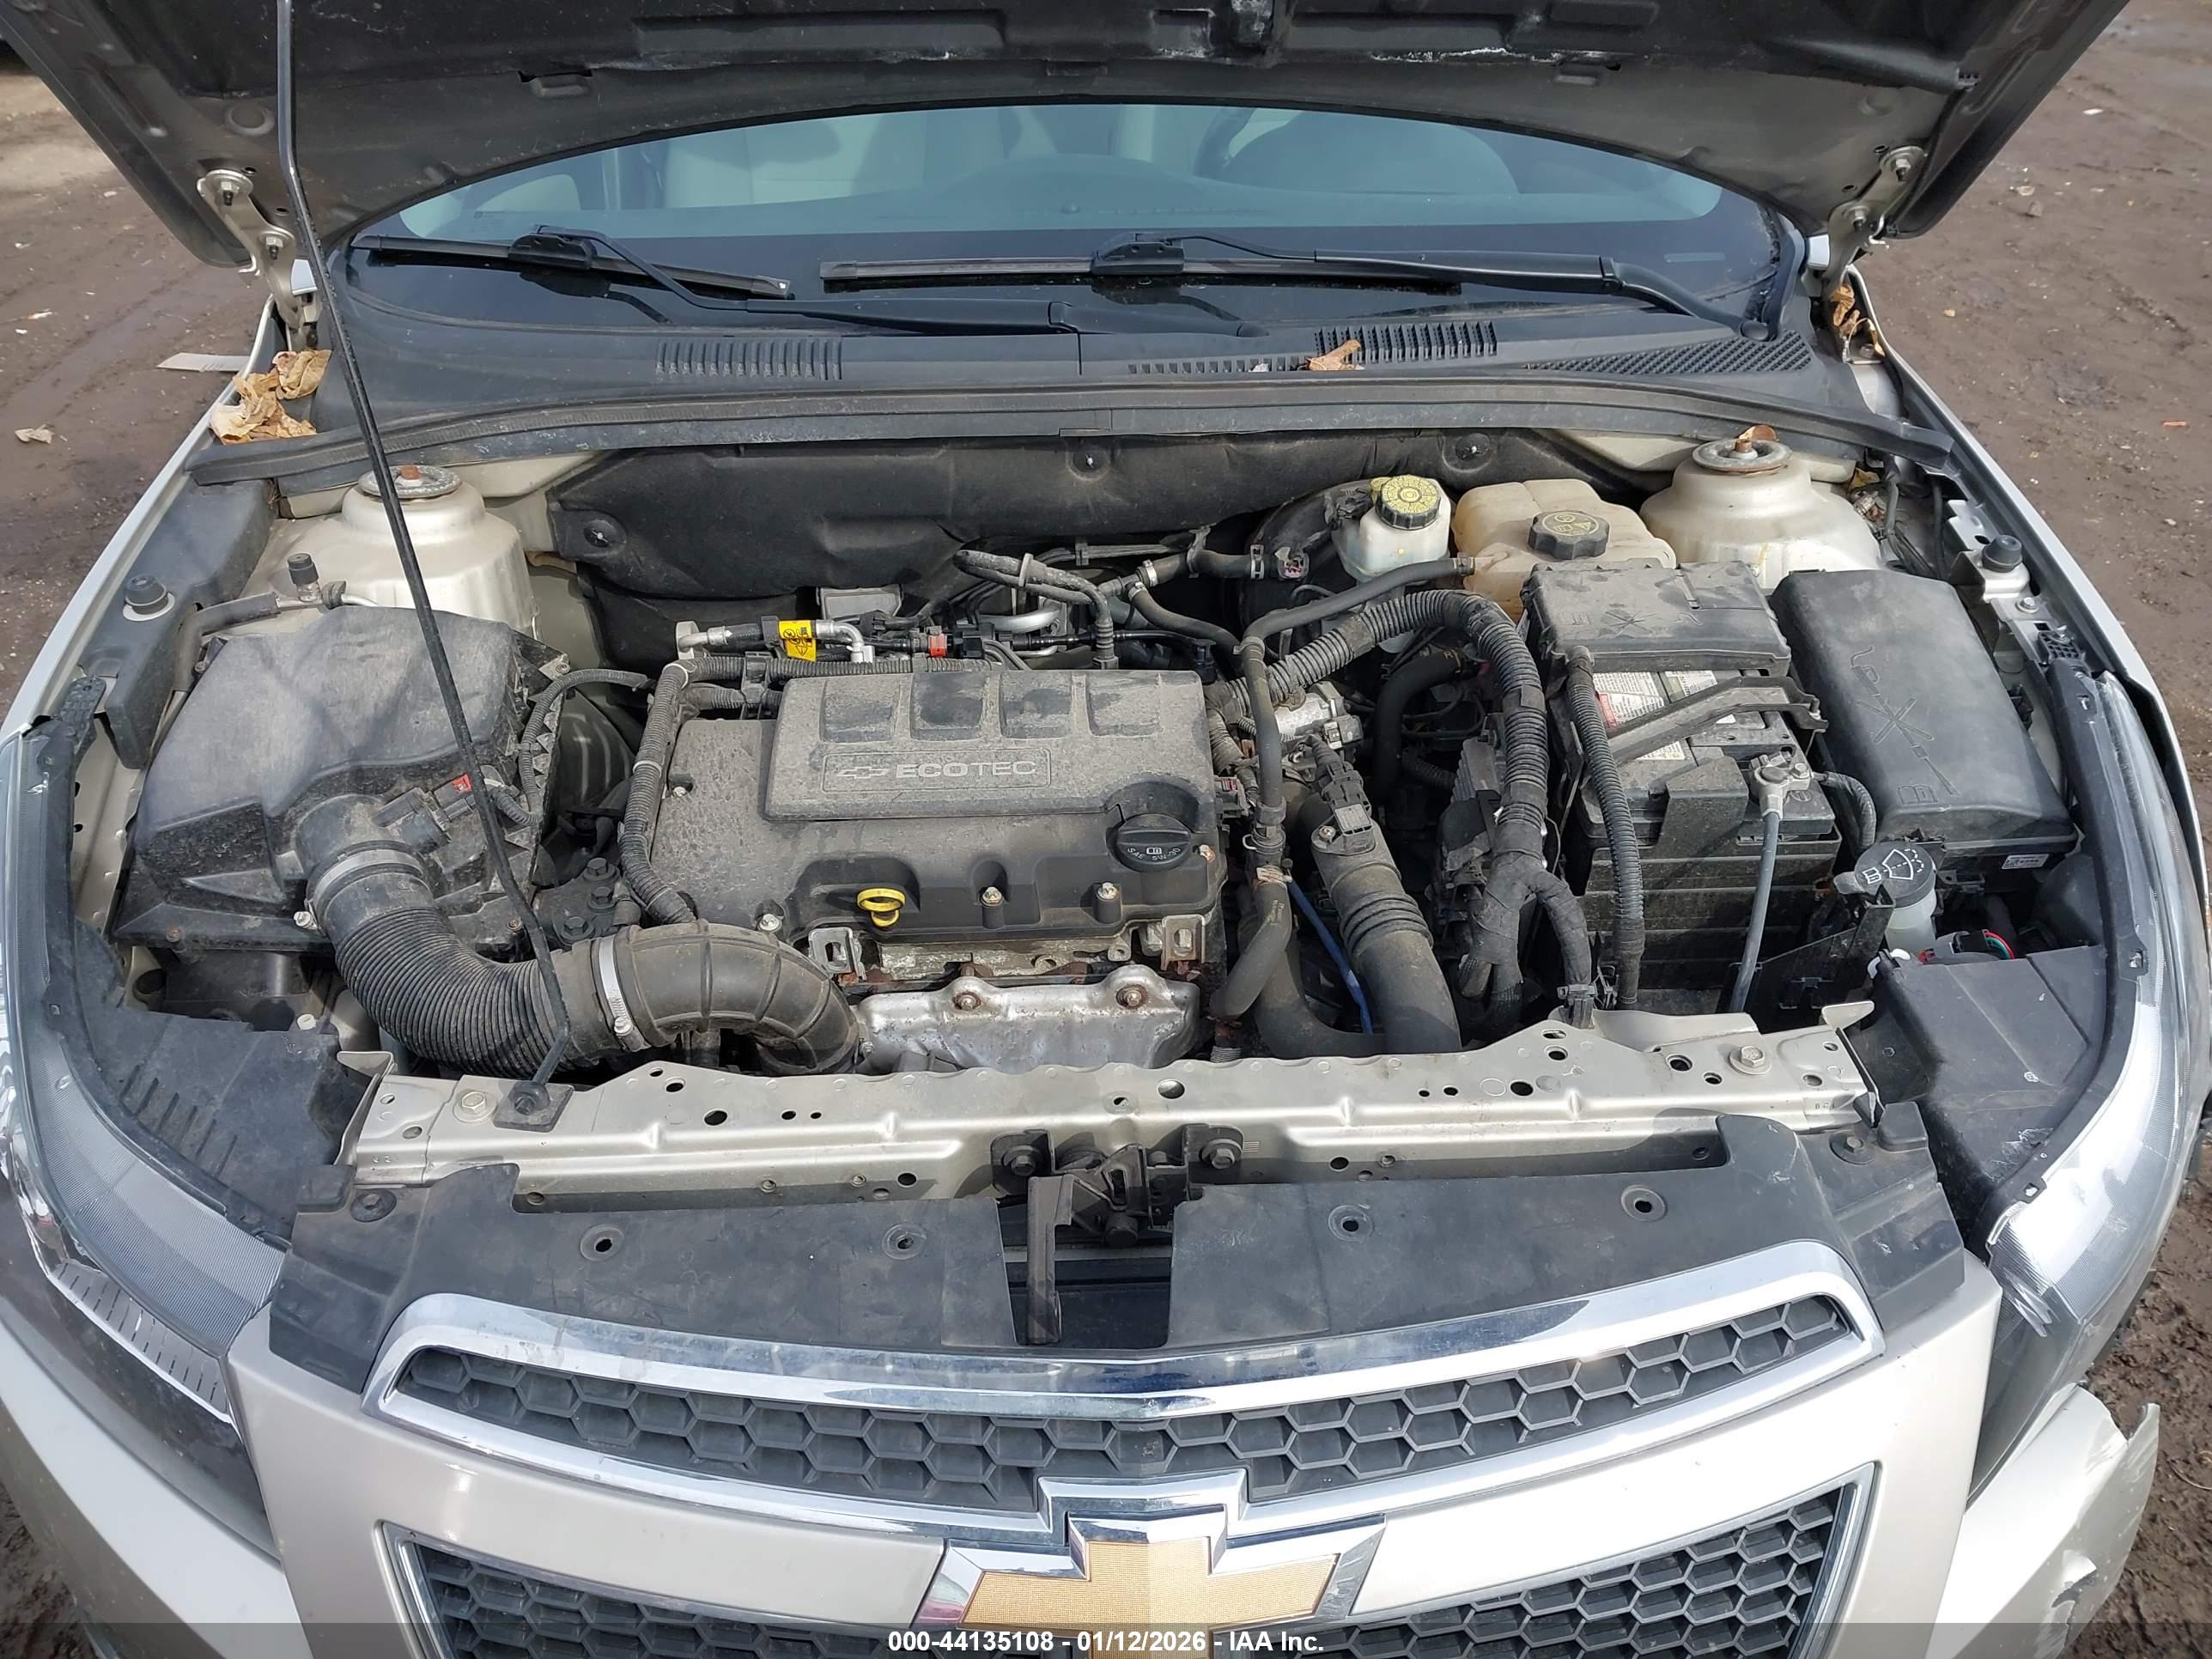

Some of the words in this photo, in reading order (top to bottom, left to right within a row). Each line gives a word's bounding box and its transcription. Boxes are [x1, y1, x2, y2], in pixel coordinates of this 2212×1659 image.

[896, 760, 1037, 778] ECOTEC
[1127, 848, 1146, 860] SAE
[1152, 848, 1182, 861] 5W-30
